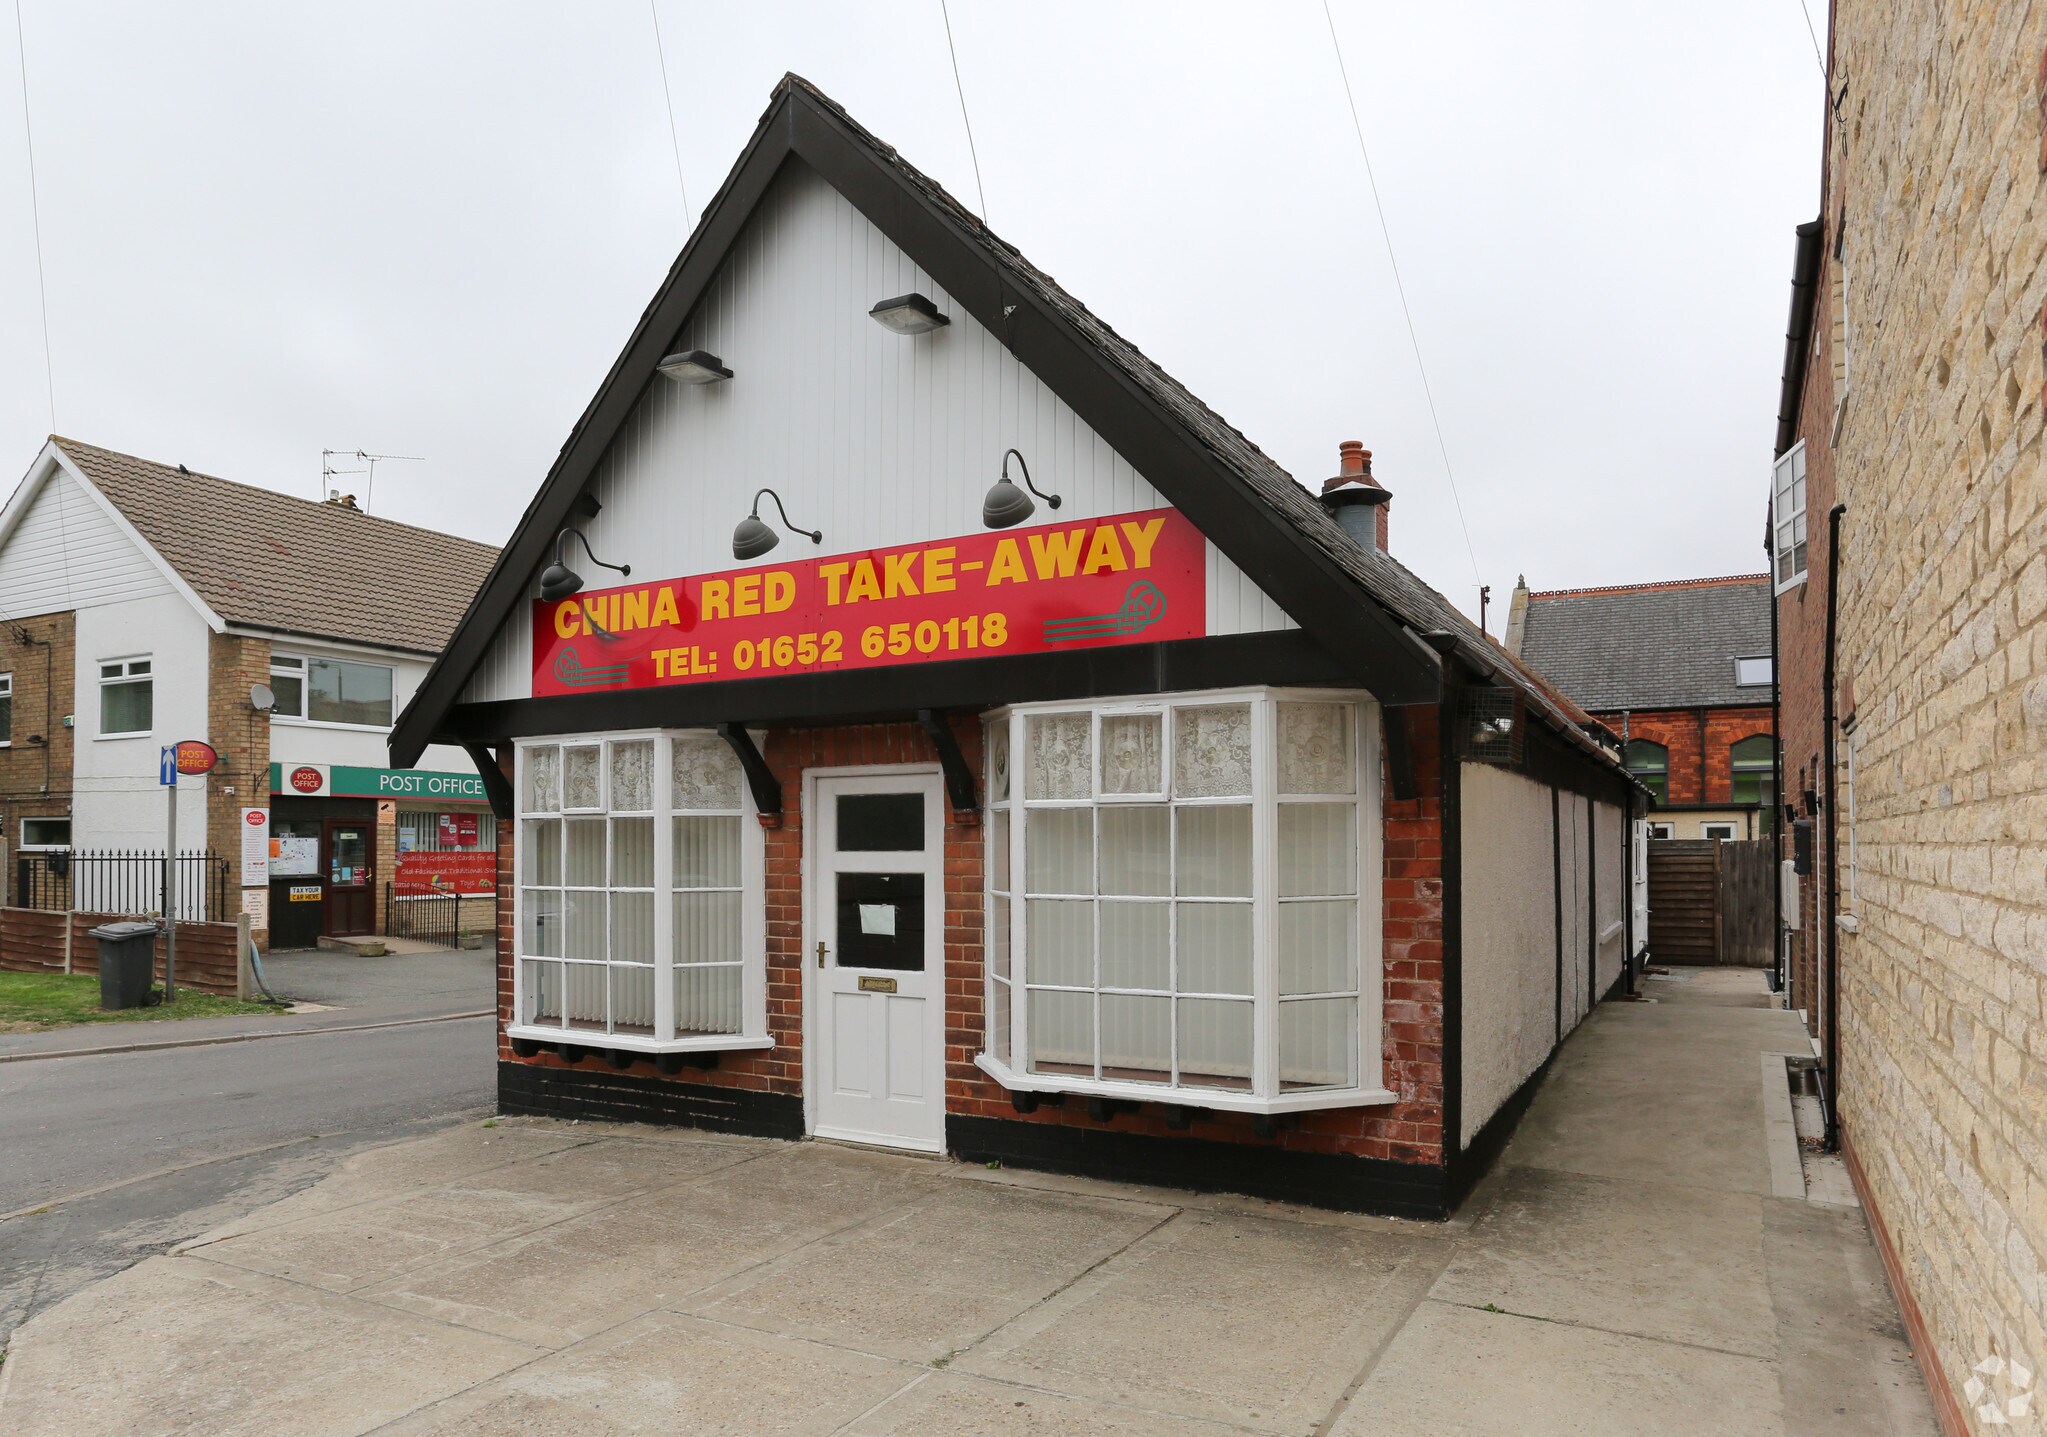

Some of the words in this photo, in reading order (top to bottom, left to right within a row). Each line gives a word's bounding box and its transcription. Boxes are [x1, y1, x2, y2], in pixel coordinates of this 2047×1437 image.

[554, 586, 680, 639] CHINA
[701, 570, 797, 621] RED
[819, 517, 1166, 607] TAKE-AWAY
[651, 645, 717, 678] TEL:
[733, 630, 843, 671] 01652
[860, 612, 1008, 659] 650118
[181, 750, 205, 758] POST
[177, 759, 208, 768] OFFICE
[294, 780, 319, 788] OFFICE
[380, 774, 423, 792] POST
[428, 778, 482, 794] OFFICE
[402, 855, 427, 864] Quality
[429, 854, 456, 863] Greeting
[477, 854, 485, 862] for
[460, 880, 475, 888] Toys
